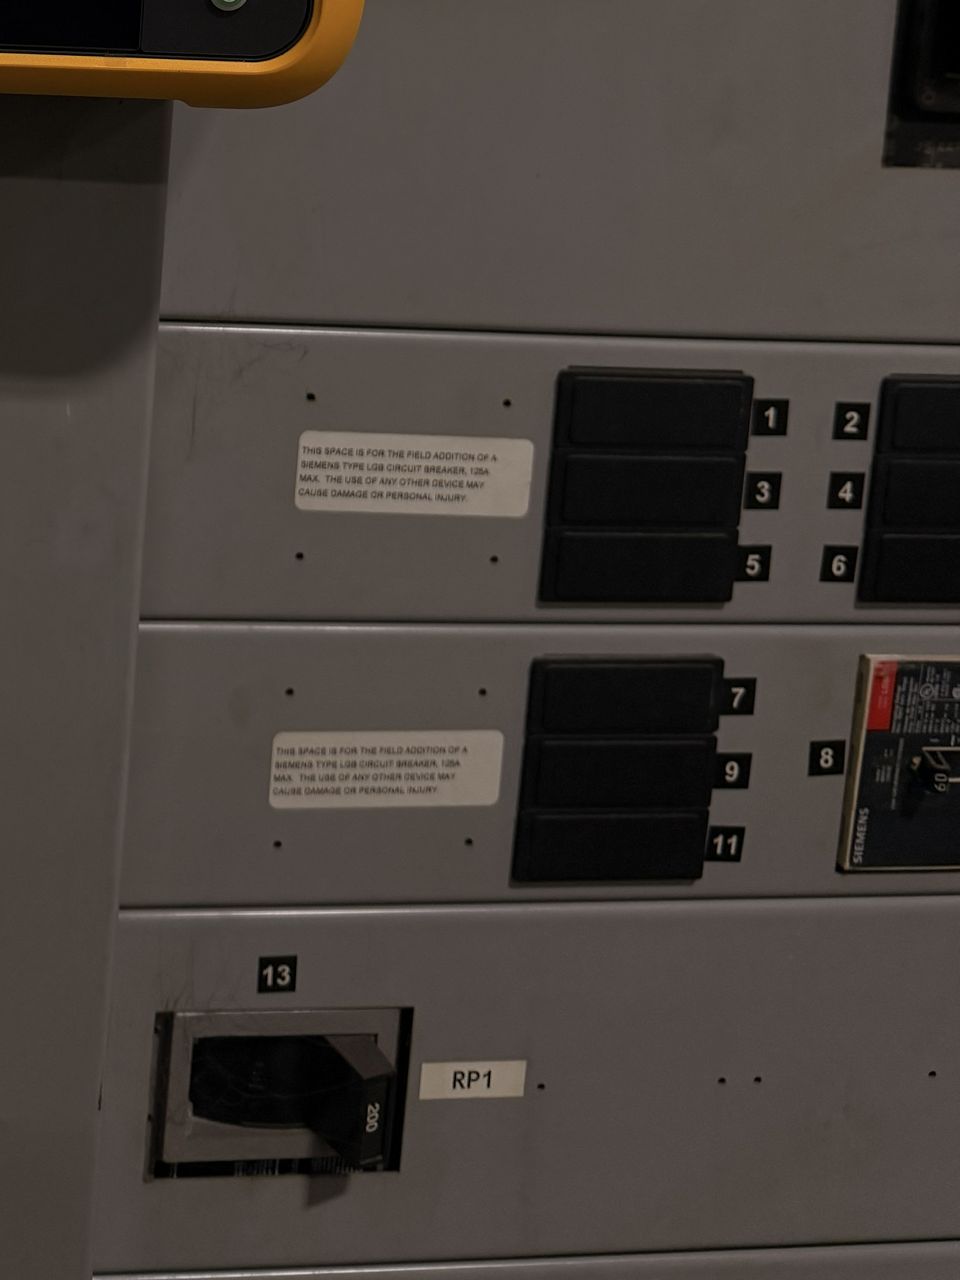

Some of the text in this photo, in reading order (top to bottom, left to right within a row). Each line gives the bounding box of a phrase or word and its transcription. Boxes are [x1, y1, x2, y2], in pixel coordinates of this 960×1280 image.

[764, 406, 776, 428] 1
[844, 411, 860, 433] 2
[755, 481, 771, 503] 3
[838, 481, 853, 503] 4
[746, 554, 761, 575] 5
[832, 555, 847, 576] 6
[731, 687, 746, 709] 7
[819, 748, 834, 768] 8
[725, 761, 740, 782] 9
[713, 834, 738, 856] 11
[853, 807, 869, 864] SIEMENS
[262, 964, 291, 987] 13
[452, 1069, 493, 1090] RP1
[365, 1102, 381, 1133] 200
